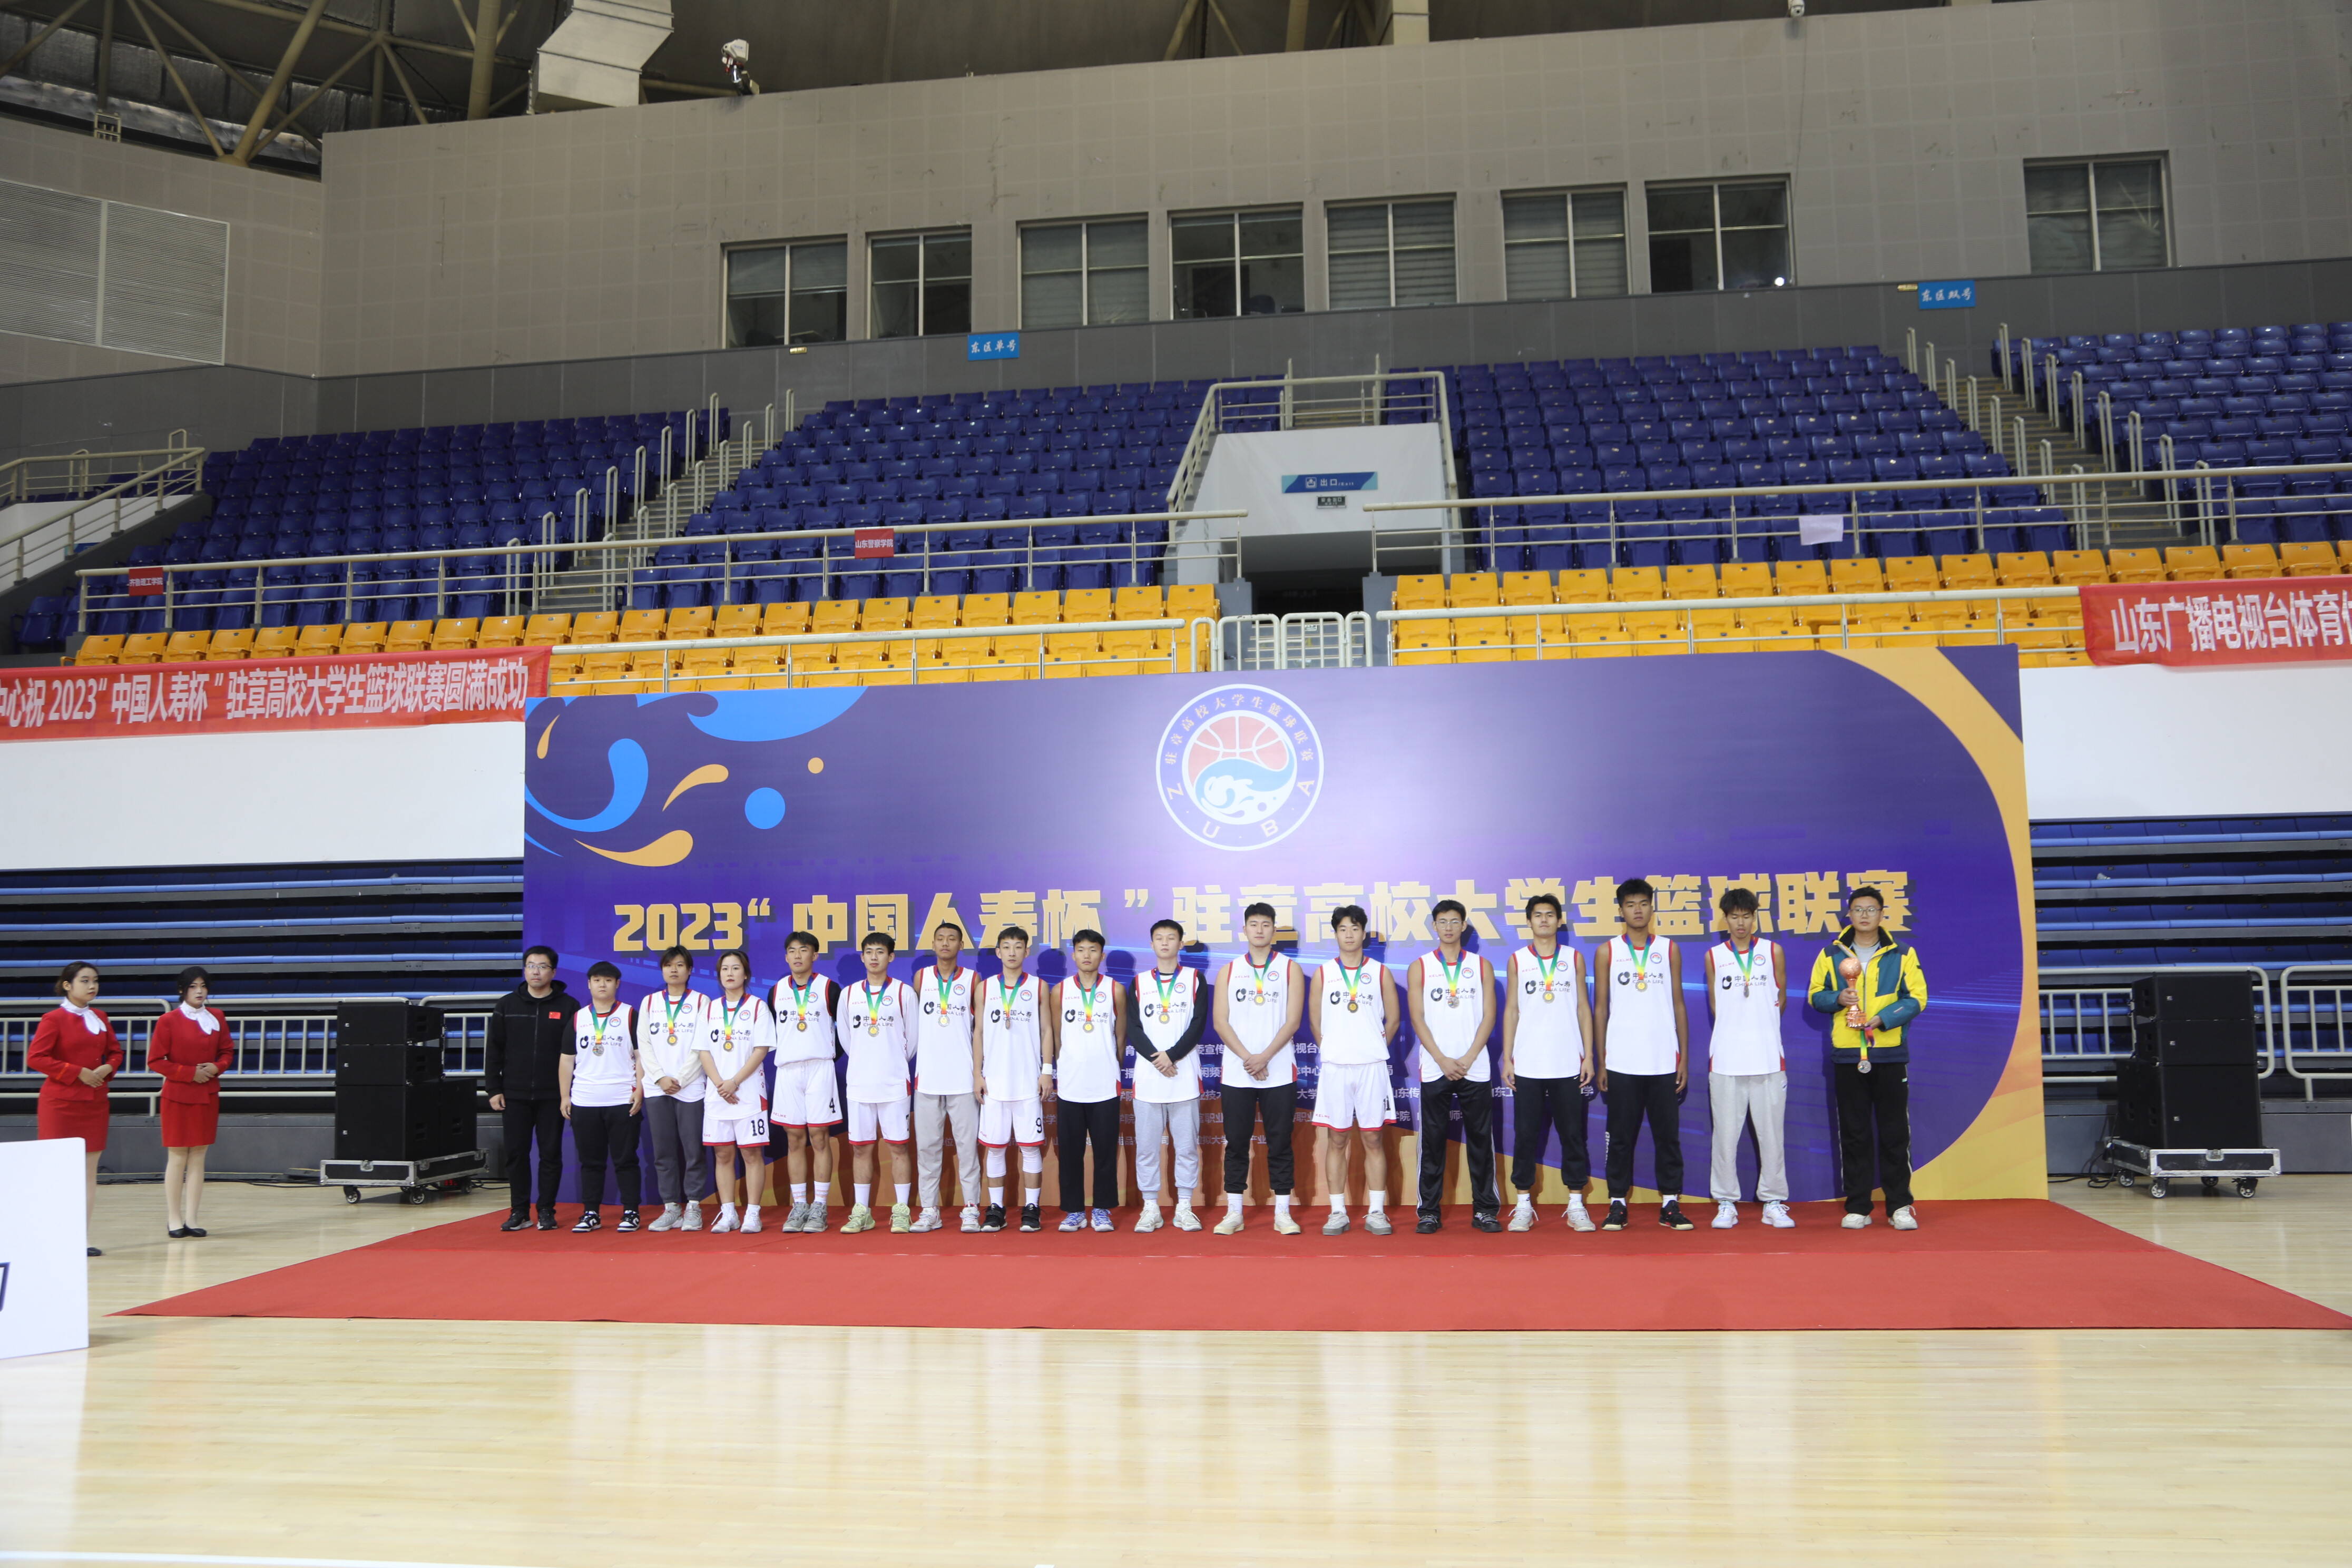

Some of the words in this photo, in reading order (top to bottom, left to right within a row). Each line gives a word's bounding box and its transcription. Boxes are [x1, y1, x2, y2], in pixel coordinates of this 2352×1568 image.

[1249, 990, 1279, 998] 中人寿
[829, 1097, 836, 1113] 4
[751, 1119, 765, 1136] 18
[1036, 1118, 1043, 1133] 9
